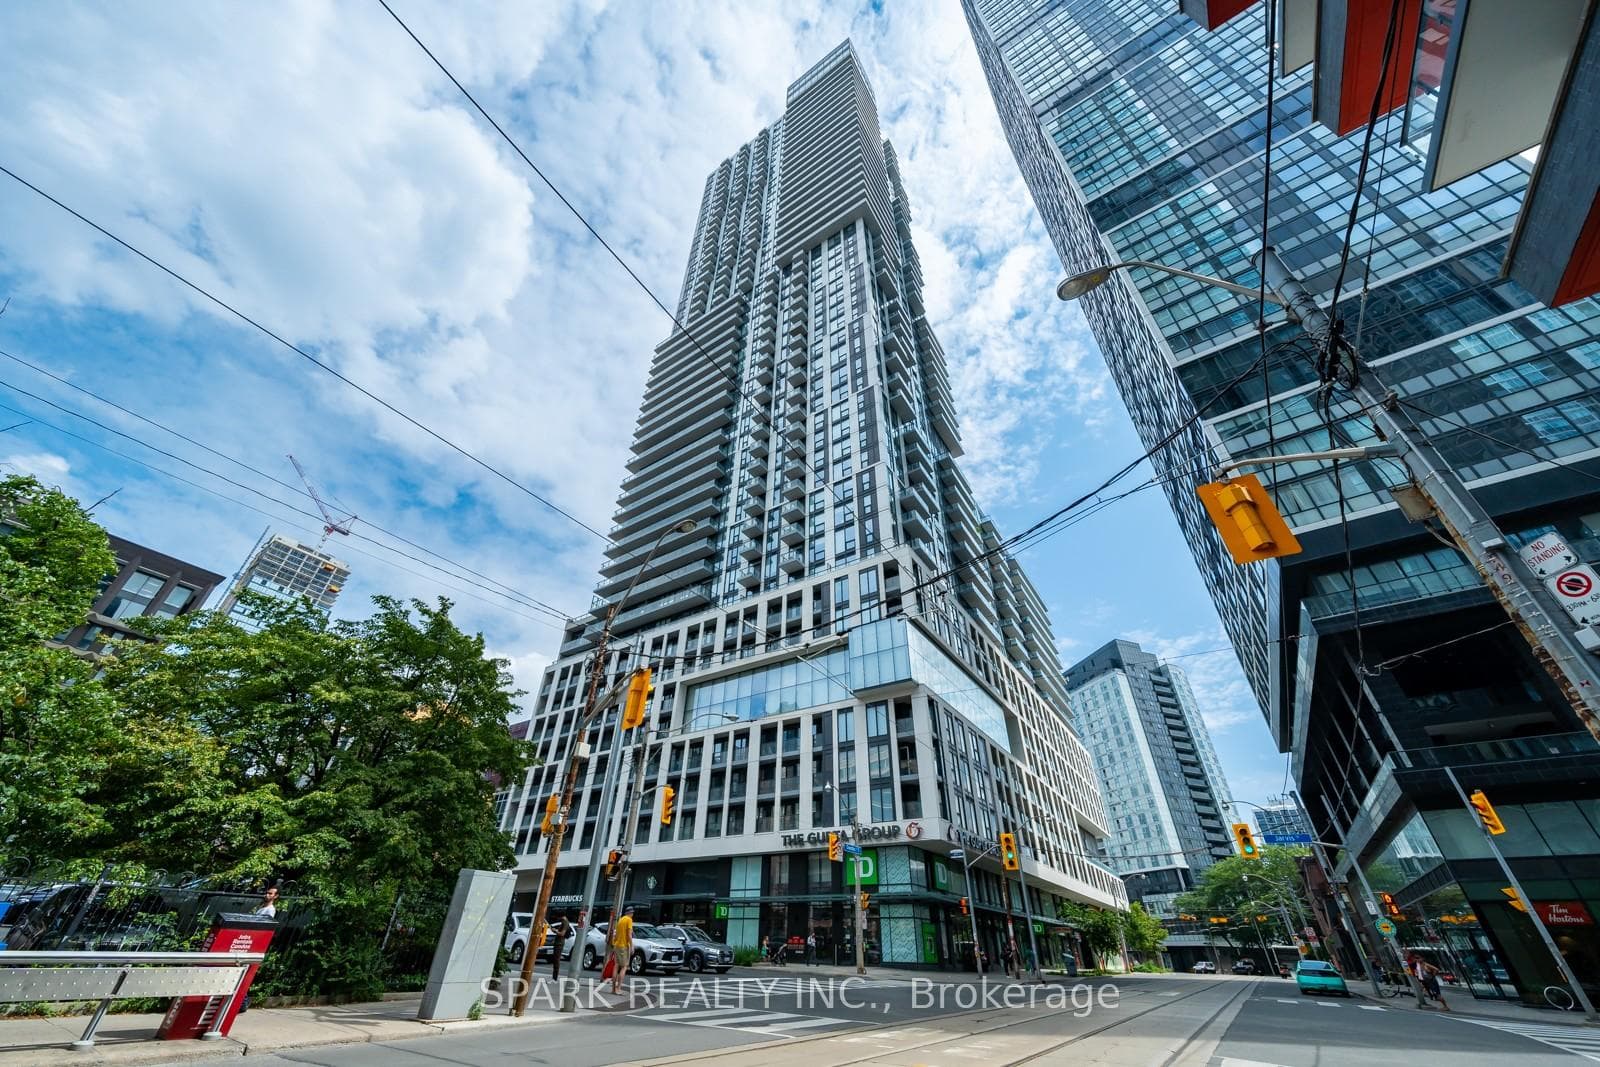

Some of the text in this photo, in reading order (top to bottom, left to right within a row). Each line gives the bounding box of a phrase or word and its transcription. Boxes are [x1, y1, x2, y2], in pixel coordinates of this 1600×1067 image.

[1530, 541, 1546, 552] NO
[1527, 543, 1566, 567] STANDING
[781, 833, 805, 847] THE
[551, 894, 583, 903] STARBUCKS
[1549, 904, 1568, 913] Tim
[1549, 914, 1584, 923] Hortons
